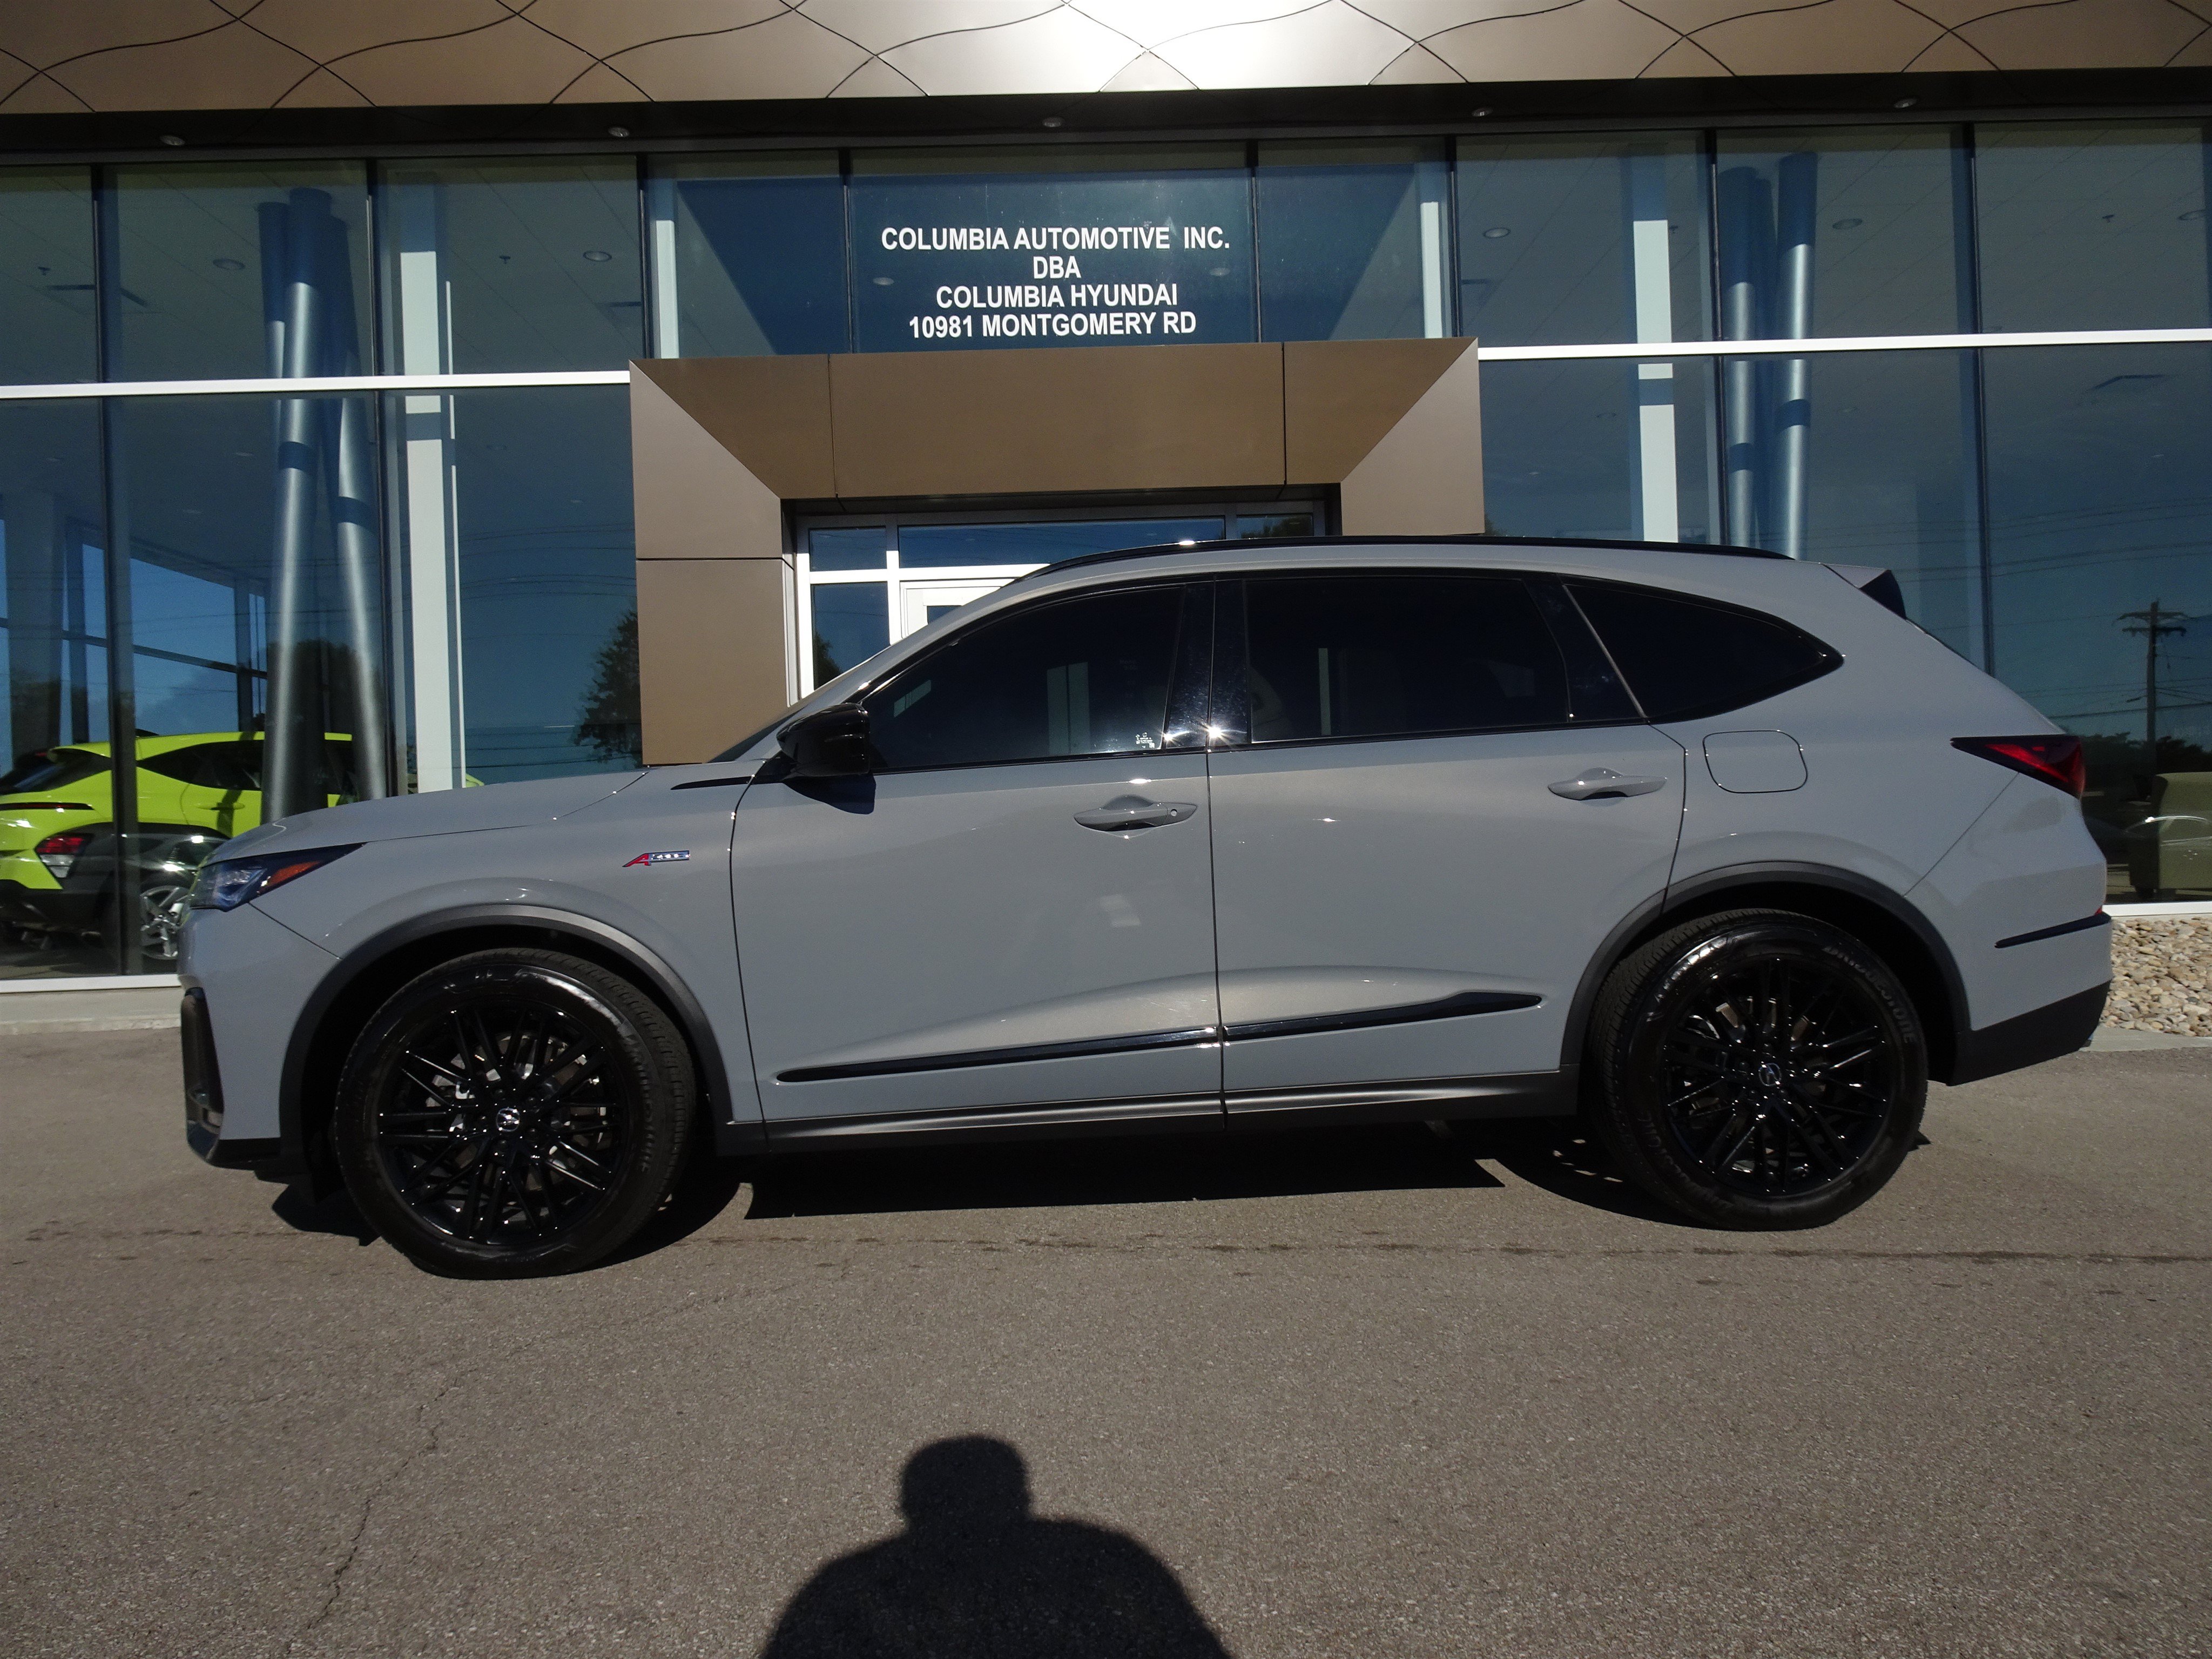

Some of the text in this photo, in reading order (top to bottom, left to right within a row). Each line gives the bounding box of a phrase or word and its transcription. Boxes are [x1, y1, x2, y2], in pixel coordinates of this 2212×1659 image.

[881, 226, 1230, 251] COLUMBIA AUTOMOTIVE INC.
[1033, 255, 1082, 279] DBA
[936, 283, 1177, 308] COLUMBIA HYUNDAI
[909, 311, 1196, 338] 10981 MONTGOMERY RD
